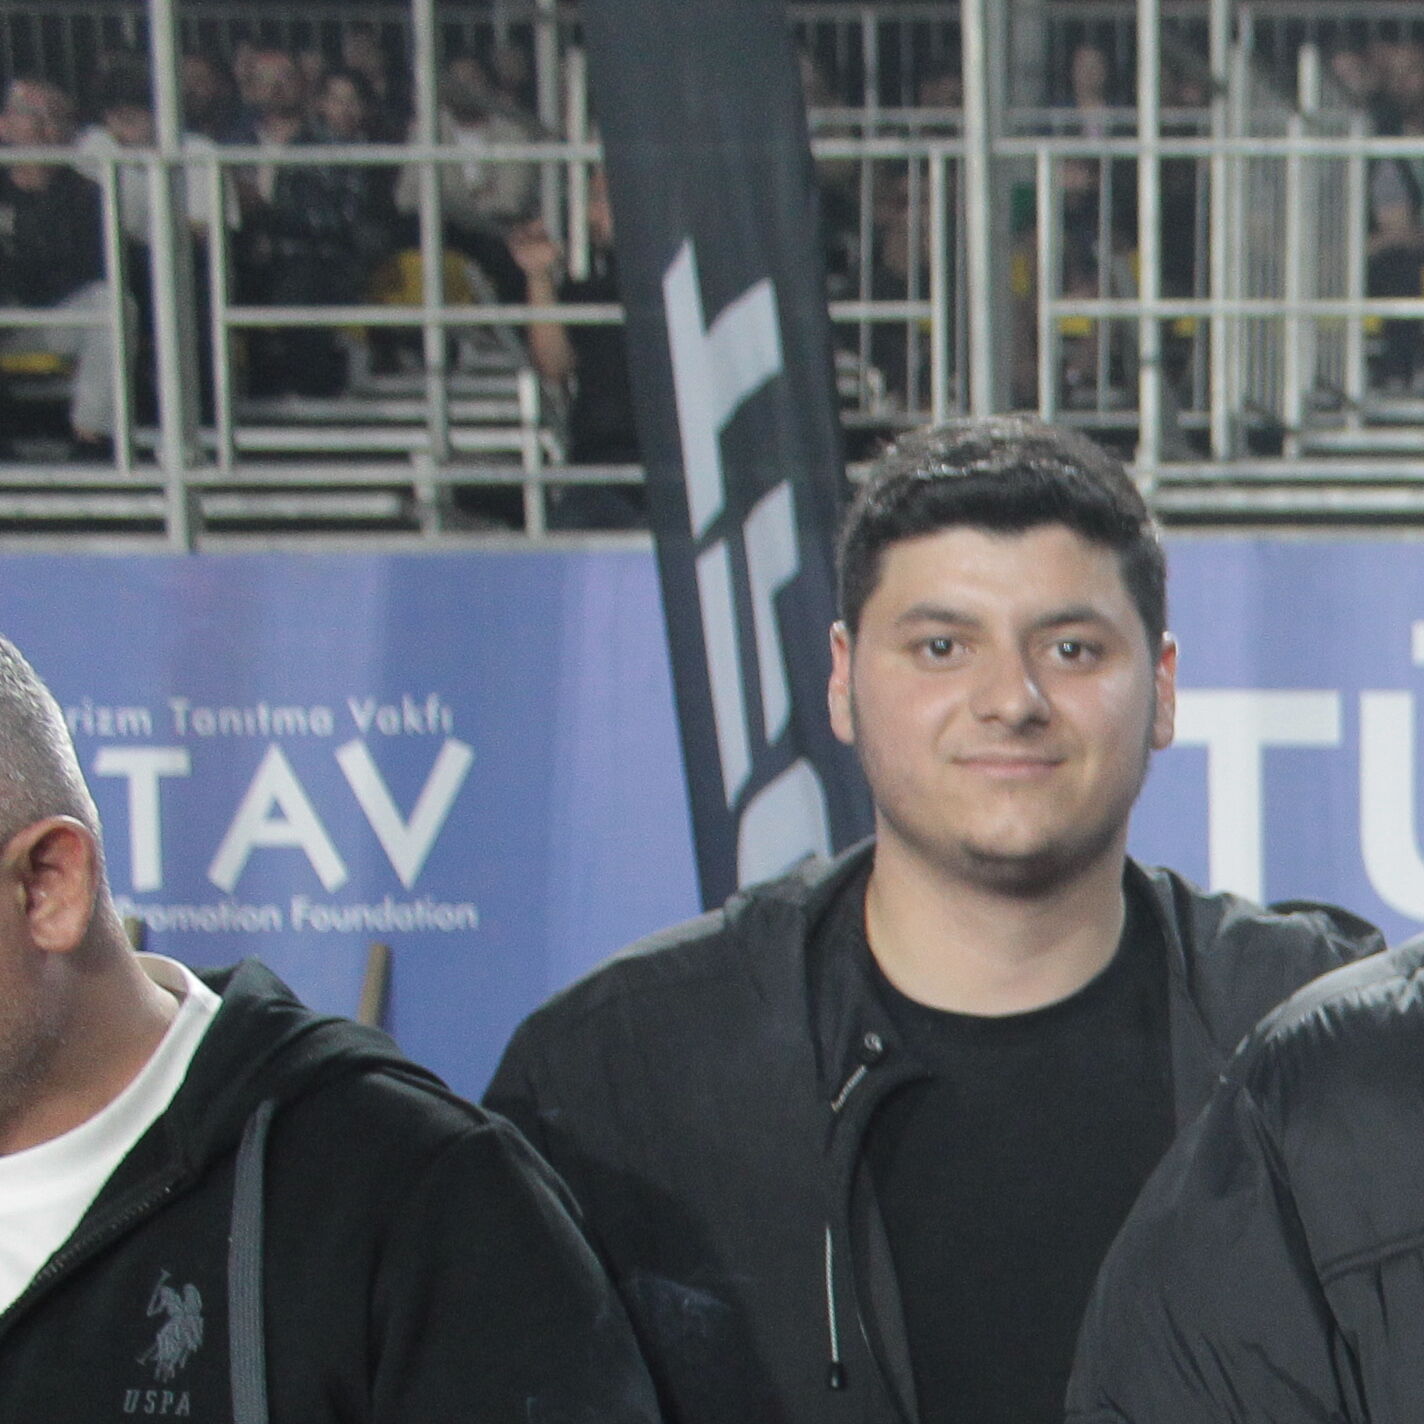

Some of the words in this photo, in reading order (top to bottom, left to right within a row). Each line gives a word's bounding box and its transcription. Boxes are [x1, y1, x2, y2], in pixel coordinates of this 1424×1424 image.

[65, 697, 153, 737] rizm
[346, 692, 456, 738] Vakfı
[291, 893, 479, 933] Foundation
[123, 1389, 191, 1416] USPA
